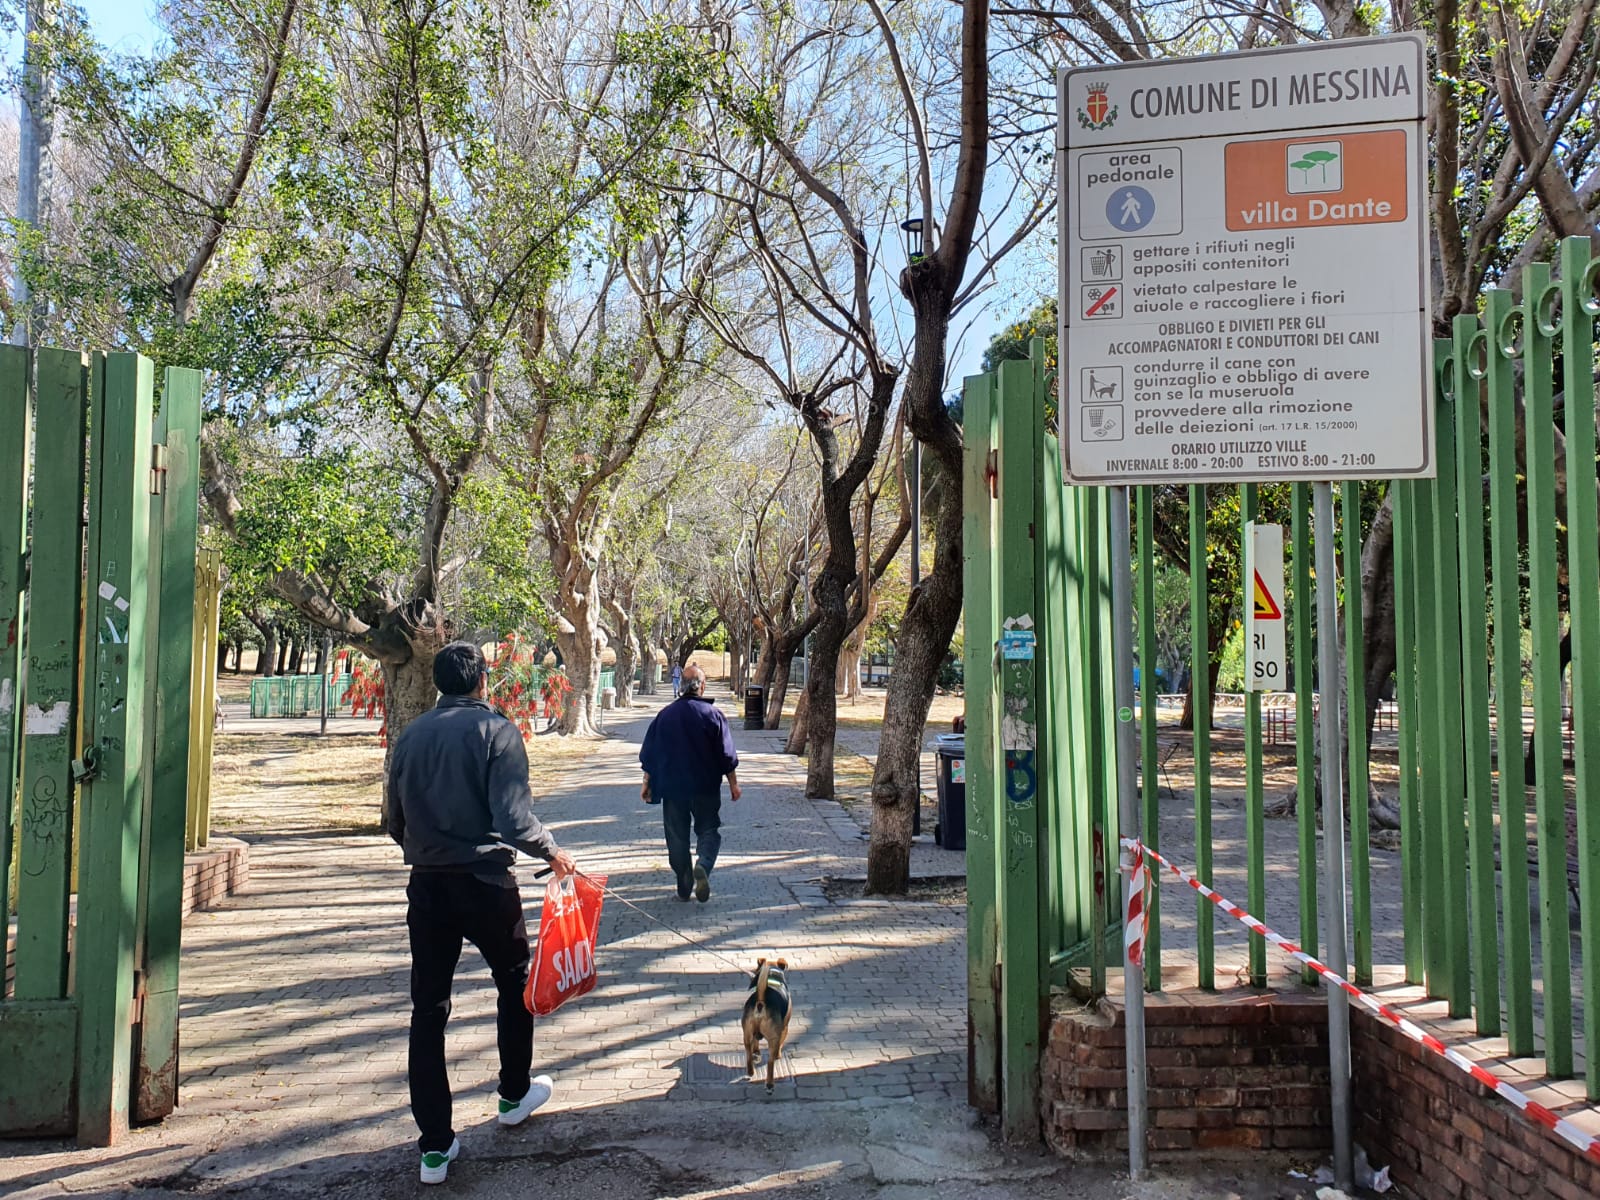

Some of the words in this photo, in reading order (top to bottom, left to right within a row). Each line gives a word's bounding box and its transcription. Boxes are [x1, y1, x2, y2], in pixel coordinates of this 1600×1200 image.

[1130, 80, 1241, 119] COMUNE
[1251, 77, 1277, 109] DI
[1289, 64, 1410, 106] MESSINA
[1109, 153, 1151, 167] area
[1087, 166, 1174, 188] pedonale
[1241, 202, 1297, 224] villa
[1308, 198, 1391, 220] Dante
[1133, 245, 1190, 261] gettare
[1195, 243, 1200, 255] i
[1205, 240, 1248, 255] rifiuti
[1254, 239, 1295, 254] negli
[1133, 259, 1196, 278] appositi
[1203, 254, 1290, 272] contenitori
[1133, 282, 1187, 297] vietato
[1193, 278, 1277, 299] calpestare
[1283, 277, 1297, 289] le
[1133, 299, 1184, 313] aiuole
[1189, 301, 1198, 310] e
[1205, 293, 1295, 314] raccogliere
[1300, 292, 1306, 305] i
[1311, 291, 1344, 304] fiori
[1159, 322, 1214, 336] OBBLIGO
[1218, 320, 1226, 333] E
[1230, 318, 1273, 332] DIVIETI
[1279, 318, 1301, 330] PER
[1306, 316, 1325, 330] GLI
[1108, 339, 1222, 355] ACCOMPAGNATORI
[1226, 336, 1233, 350] E
[1237, 333, 1318, 349] CONDUTTORI
[1323, 332, 1344, 345] DEI
[1349, 331, 1379, 345] CANI
[1134, 359, 1204, 374] condurre
[1210, 358, 1219, 369] il
[1225, 358, 1262, 369] cane
[1267, 356, 1295, 368] con
[1134, 373, 1216, 390] guinzaglio
[1222, 374, 1231, 384] e
[1237, 369, 1298, 387] obbligo
[1303, 369, 1318, 381] di
[1324, 369, 1369, 380] avere
[1134, 391, 1162, 402] con
[1167, 390, 1183, 400] se
[1188, 387, 1203, 400] la
[1209, 384, 1295, 399] museruola
[1135, 404, 1226, 422] provvedere
[1232, 402, 1263, 415] alla
[1269, 401, 1353, 414] rimozione
[1135, 421, 1174, 435] delle
[1179, 419, 1254, 434] deiezioni
[1281, 423, 1292, 431] 17
[1316, 421, 1357, 431] 15/2000)
[1171, 442, 1215, 455] ORARIO
[1220, 441, 1272, 454] UTILIZZO
[1276, 440, 1306, 452] VILLE
[1106, 458, 1168, 472] INVERNALE
[1172, 458, 1198, 470] 8:00
[1211, 457, 1243, 469] 20:00
[1258, 455, 1298, 468] ESTIVO
[1302, 455, 1328, 466] 8:00
[1341, 454, 1375, 466] 21:00
